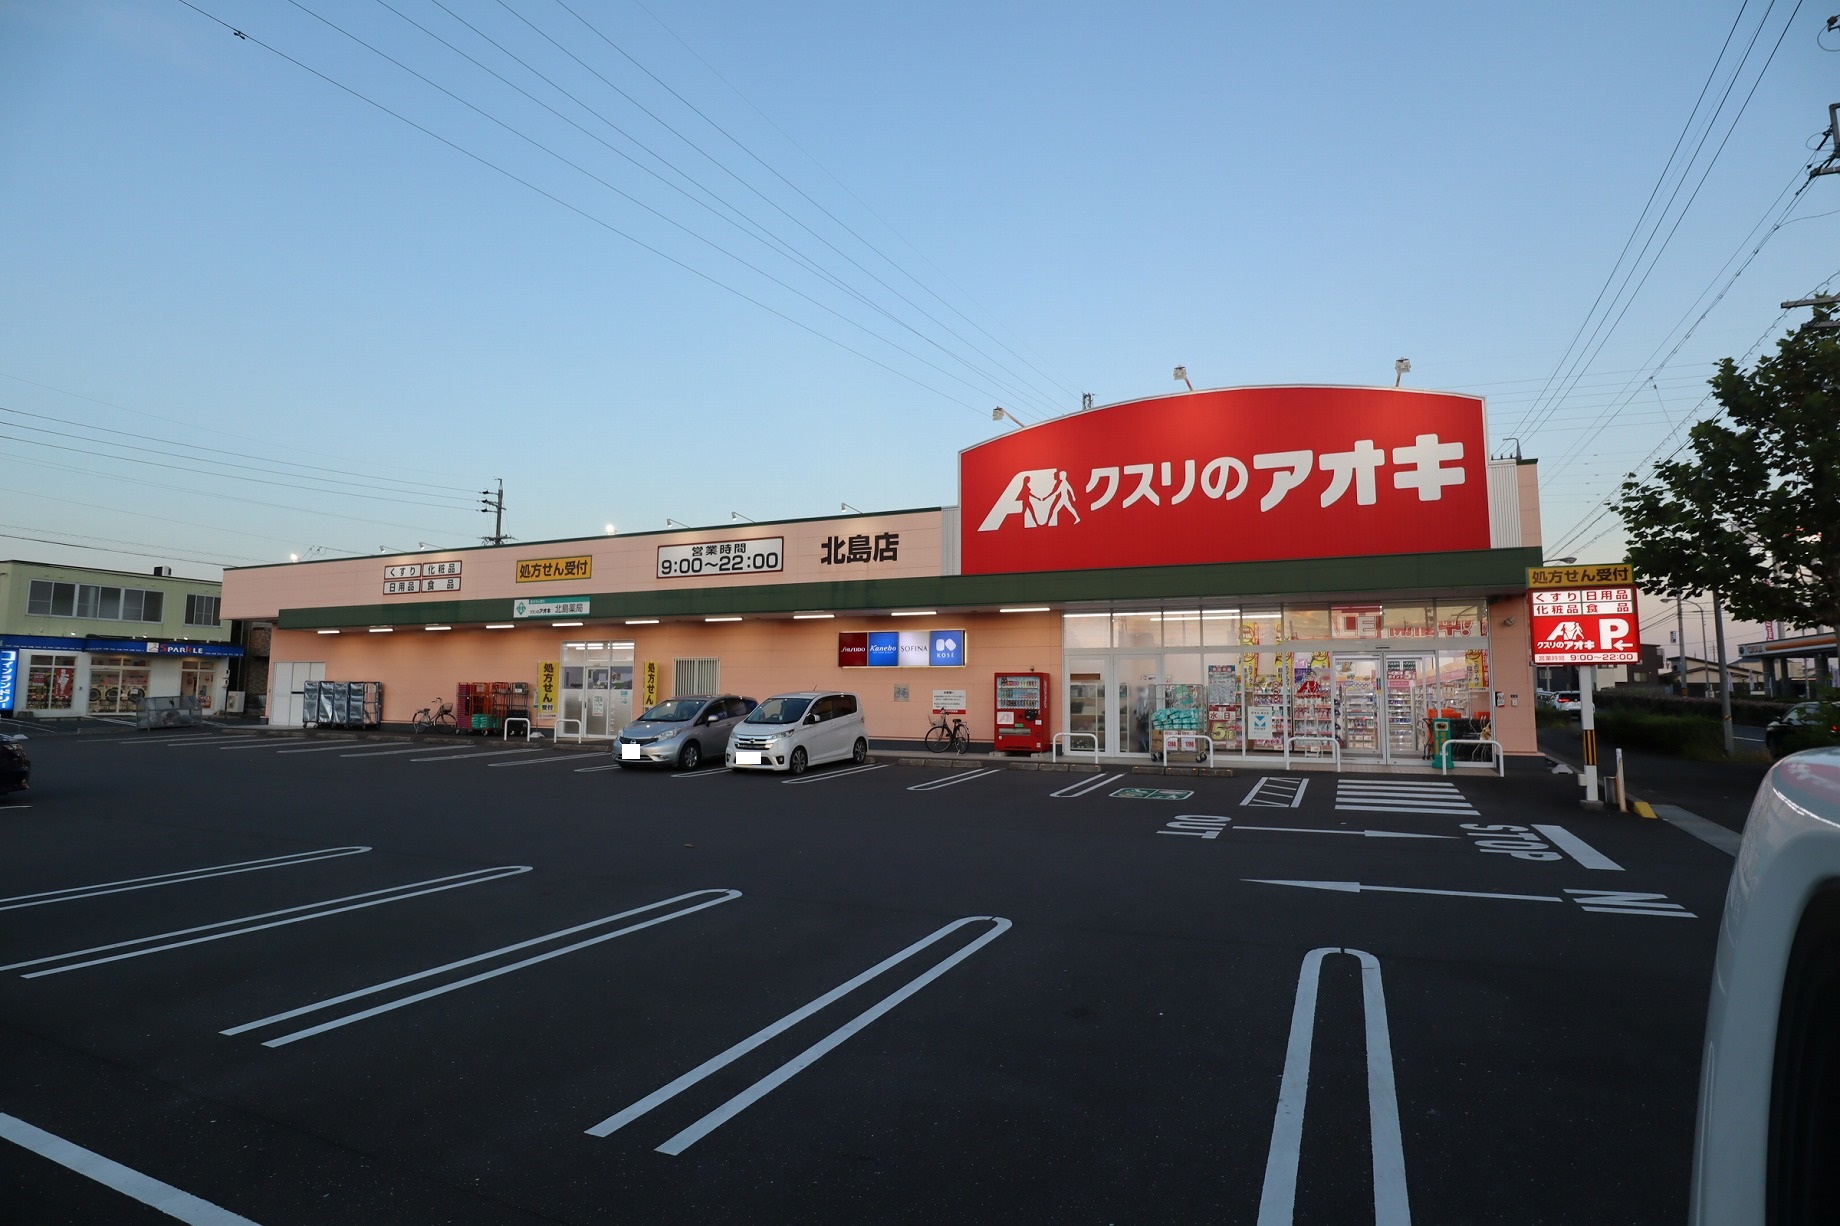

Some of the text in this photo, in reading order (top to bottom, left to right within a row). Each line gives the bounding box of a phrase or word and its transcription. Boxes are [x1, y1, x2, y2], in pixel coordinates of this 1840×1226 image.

[1085, 433, 1466, 513] クスリのアオキ
[691, 543, 746, 556] 営業時間
[821, 532, 899, 565] 北島店
[390, 566, 416, 577] くすり
[428, 563, 456, 575] 化粧品
[520, 560, 588, 578] 処方せん受付
[1532, 567, 1629, 584] 処方せん受付
[389, 581, 415, 593] 日用品
[1536, 592, 1577, 602] くすり
[1586, 590, 1628, 601] 日用品
[555, 603, 584, 613] 北島薬局
[1536, 605, 1579, 614] 化粧品
[1599, 618, 1630, 649] P
[870, 644, 897, 652] Kanebo
[1537, 640, 1595, 650] クスリのアオキ
[543, 663, 554, 703] 処方せん
[645, 662, 656, 705] 処方せん
[1156, 814, 1232, 839] OUT
[1459, 823, 1563, 861] STOP
